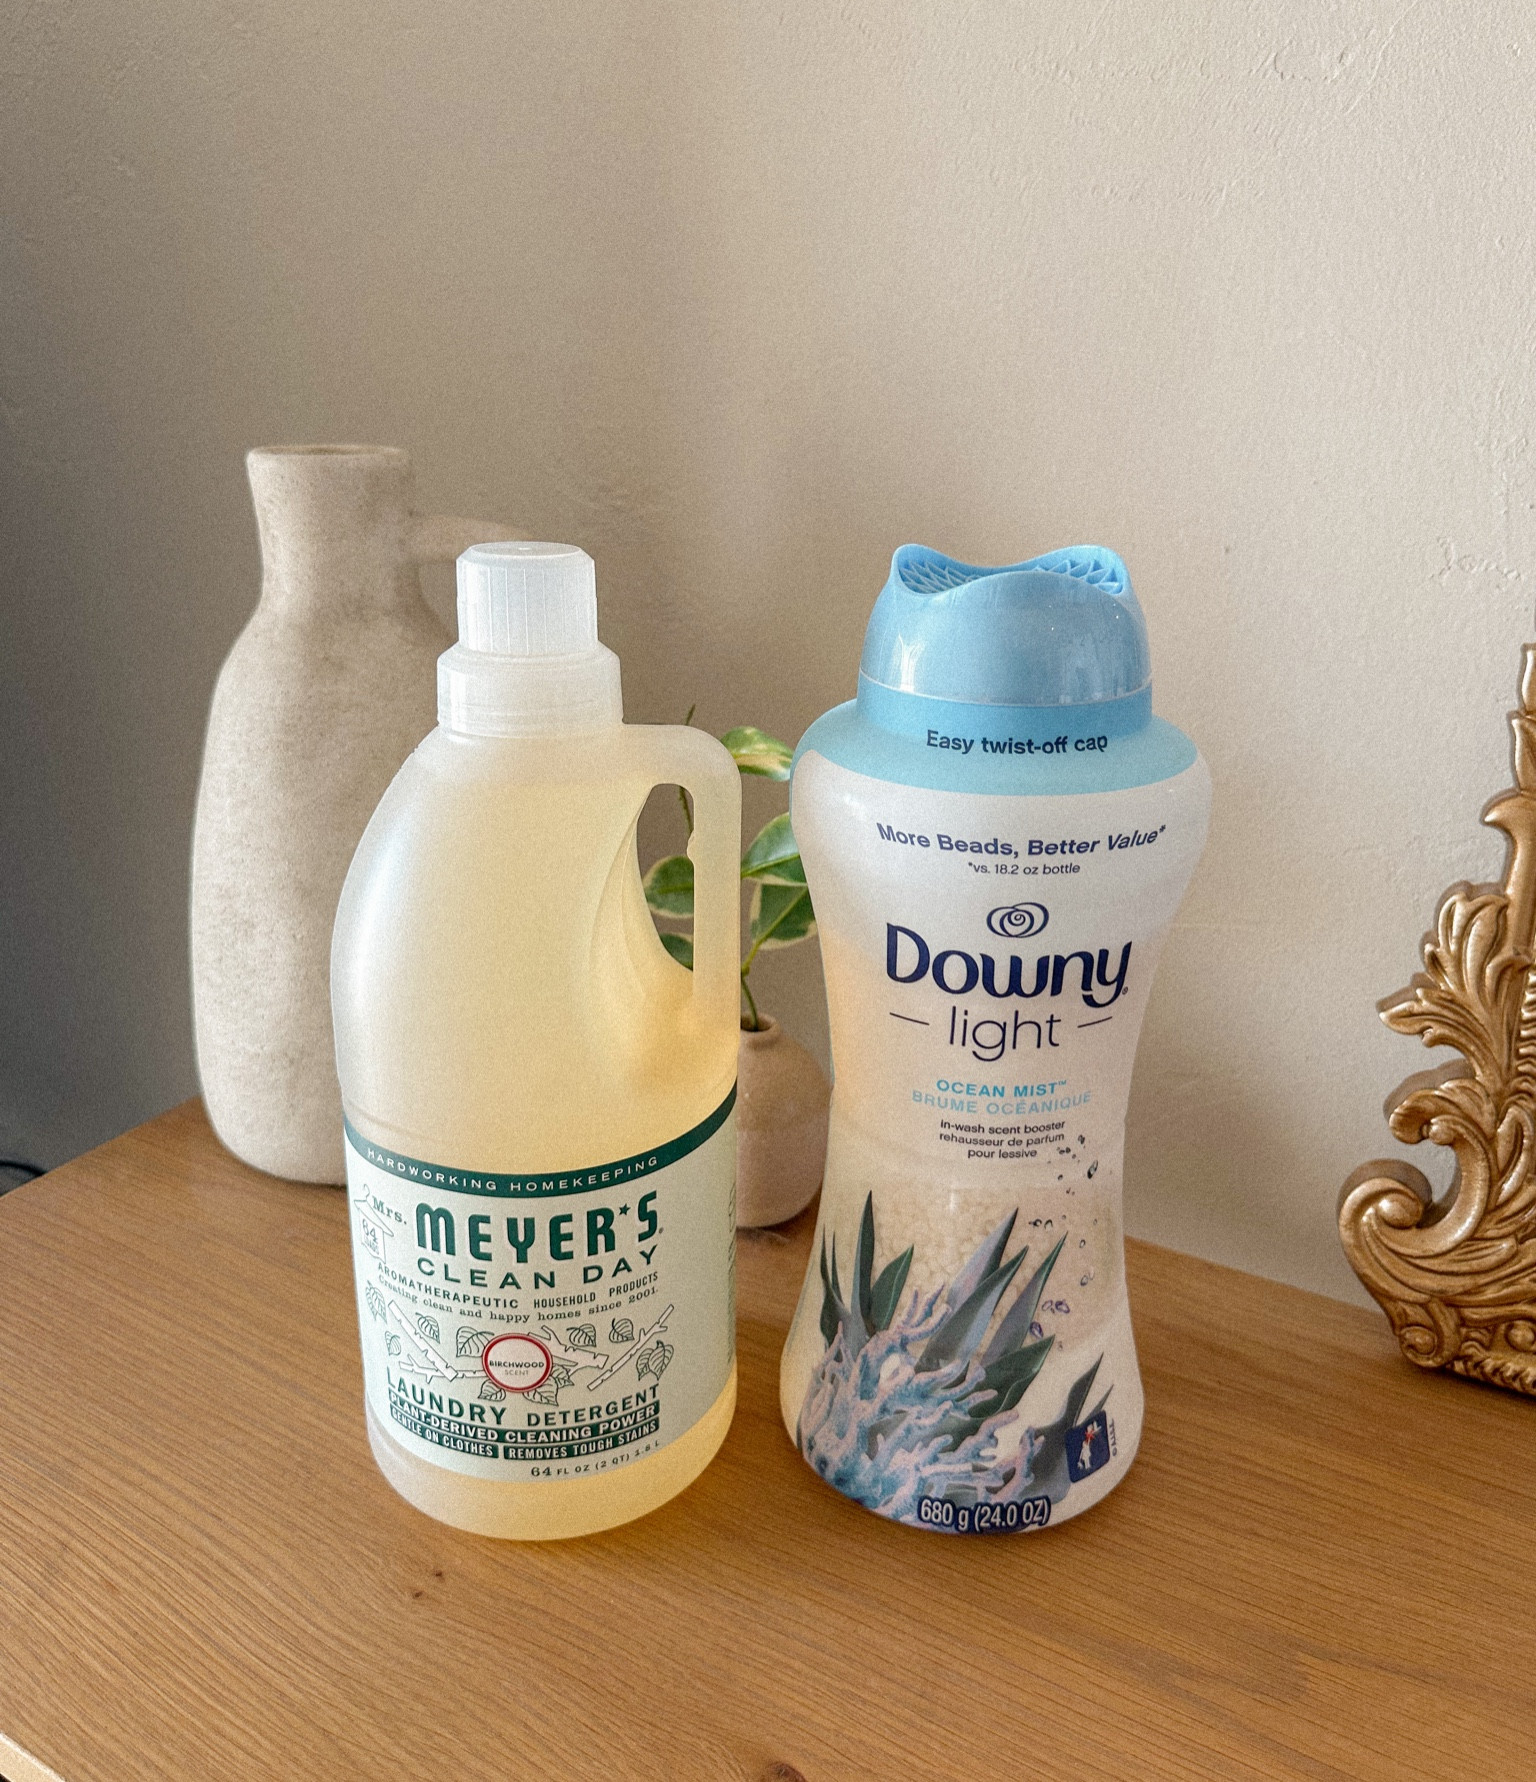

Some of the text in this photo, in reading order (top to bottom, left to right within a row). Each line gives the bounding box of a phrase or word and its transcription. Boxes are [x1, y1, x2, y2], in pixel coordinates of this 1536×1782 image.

[926, 729, 1108, 755] Easy twist-off cap
[876, 822, 931, 849] More
[937, 833, 1019, 859] Beads,
[1028, 837, 1101, 856] Better
[994, 863, 1019, 875] 18.2
[1022, 866, 1039, 875] oz
[1043, 862, 1081, 875] bottle
[886, 922, 1132, 1008] Downy
[949, 1005, 1062, 1062] light
[912, 1089, 1092, 1116] BRUME OCÉANIQUE
[936, 1079, 1005, 1098] OCEAN
[939, 1132, 1065, 1148] rehausseur de parfum
[988, 1124, 1021, 1135] scent
[1023, 1120, 1066, 1134] booster
[367, 1147, 658, 1192] HARDWORKING HOMEKEEPING
[967, 1149, 1038, 1159] pour lessive
[371, 1194, 408, 1226] Mrs.
[417, 1244, 658, 1290] CLEAN DAY
[377, 1262, 658, 1309] AROMATHERAPEUTIC HOUSEHOLD PRODUCTS
[378, 1274, 419, 1304] Creating
[423, 1297, 453, 1313] clean
[460, 1308, 482, 1319] and
[489, 1310, 531, 1324] happy
[537, 1311, 581, 1321] homes
[588, 1300, 622, 1315] since
[489, 1360, 545, 1369] BIRCHWOOD
[386, 1365, 660, 1427] LAUNDRY DETERGENT
[389, 1391, 656, 1444] PLANT-DERIVED CLEANING POWER
[391, 1406, 493, 1456] GENTLE ON CLOTHES
[508, 1420, 657, 1459] REMOVES TOUGH STAINS
[531, 1466, 552, 1477] 64
[556, 1467, 570, 1475] FL
[574, 1464, 590, 1472] OZ
[595, 1460, 607, 1470] (2
[612, 1453, 630, 1465] QT)
[919, 1498, 1049, 1532] 680 g (24.0 OZ)
